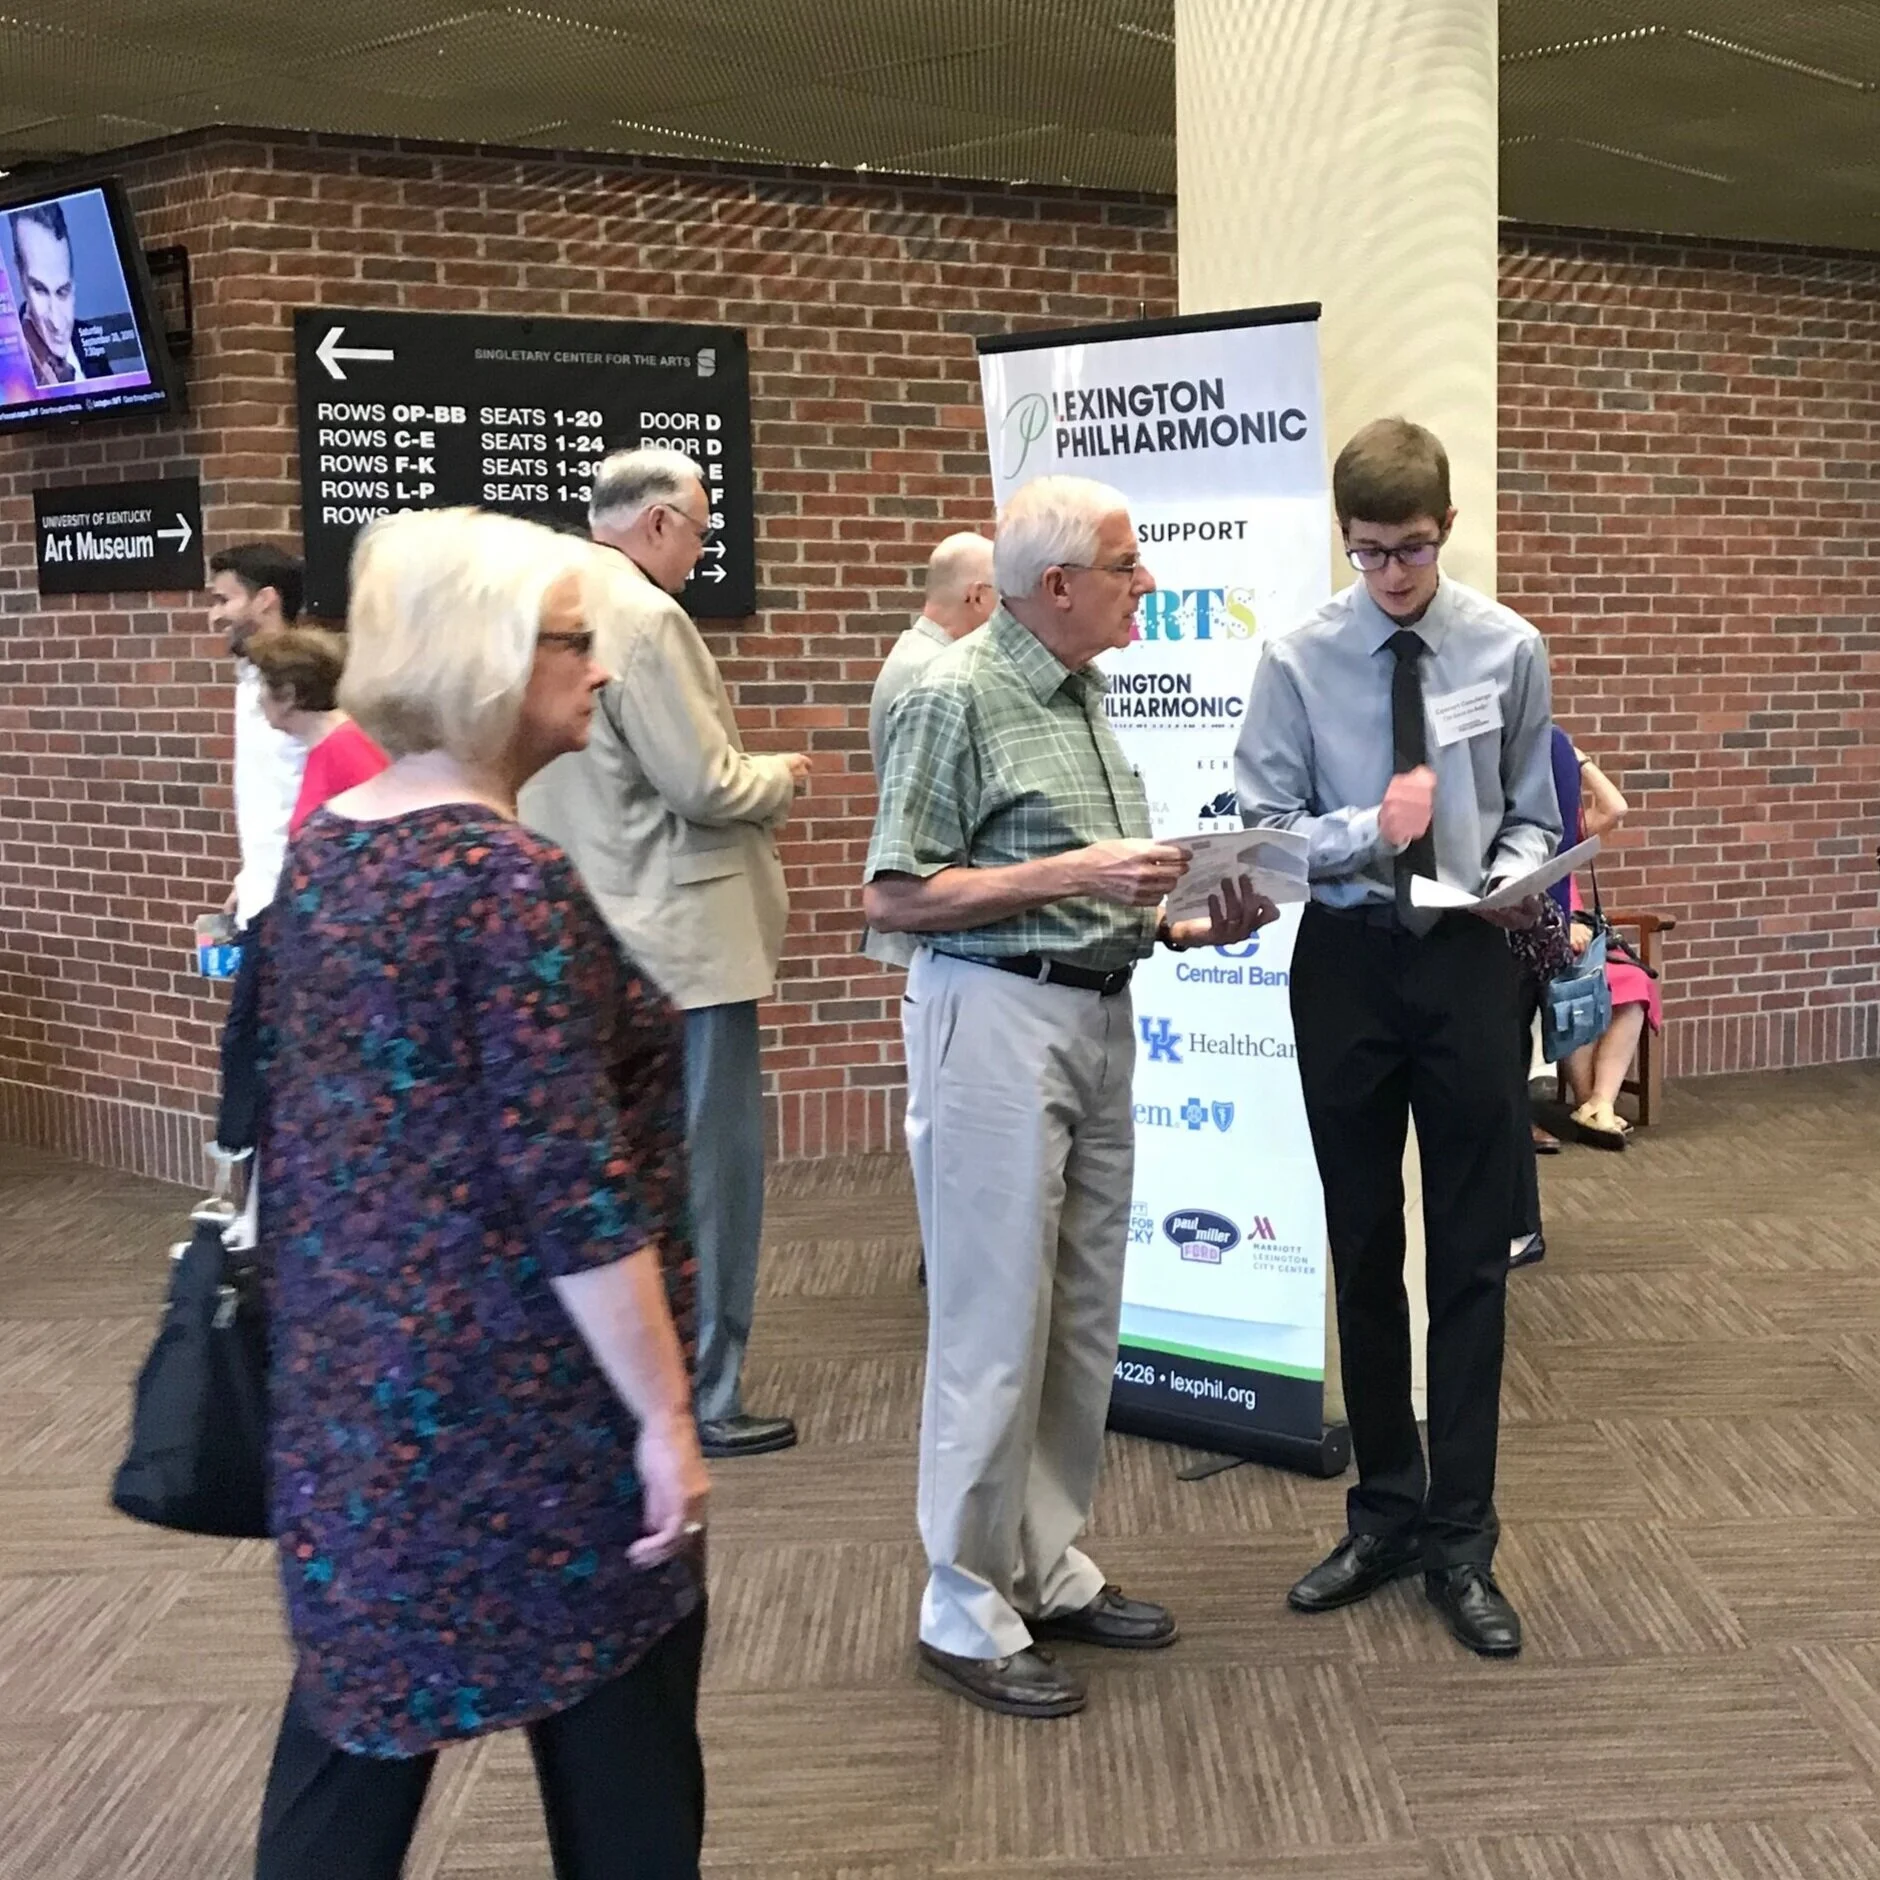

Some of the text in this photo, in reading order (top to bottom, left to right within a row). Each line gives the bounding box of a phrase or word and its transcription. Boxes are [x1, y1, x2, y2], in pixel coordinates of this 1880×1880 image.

[474, 348, 691, 367] SINGLETARY CENTER FOR THE ARTS
[1053, 378, 1225, 422] LEXINGTON
[318, 403, 721, 431] ROWS OP-BB SEATS 1-20 DOOR D
[319, 429, 387, 447] ROWS
[394, 430, 435, 448] C-E
[481, 432, 547, 451] SEATS
[555, 435, 605, 452] 1-24
[706, 439, 722, 455] D
[1056, 408, 1308, 459] PHILHARMONIC
[320, 455, 388, 473] ROWS
[395, 456, 436, 474] F-K
[482, 458, 548, 476] SEATS
[709, 464, 723, 480] E
[321, 480, 724, 504] ROWS L-P SEATS 1-3 F
[42, 510, 152, 528] UNIVERSITY OF KENTUCKY
[1138, 520, 1248, 543] SUPPORT
[44, 531, 154, 563] Art Museum
[1105, 696, 1244, 718] ILHARMONIC
[1198, 760, 1228, 770] KEN
[1198, 821, 1235, 831] COU
[1176, 962, 1289, 987] Central Ban
[1189, 1032, 1297, 1058] HealthCar
[1172, 1217, 1199, 1234] paul
[1195, 1227, 1231, 1243] miller
[1184, 1244, 1218, 1260] FORD
[1253, 1243, 1302, 1253] MARRIOTT
[1253, 1253, 1308, 1264] LEXINGTON
[1253, 1262, 1316, 1274] CITY CENTER
[1114, 1361, 1256, 1410] 4226 lexphil.org
